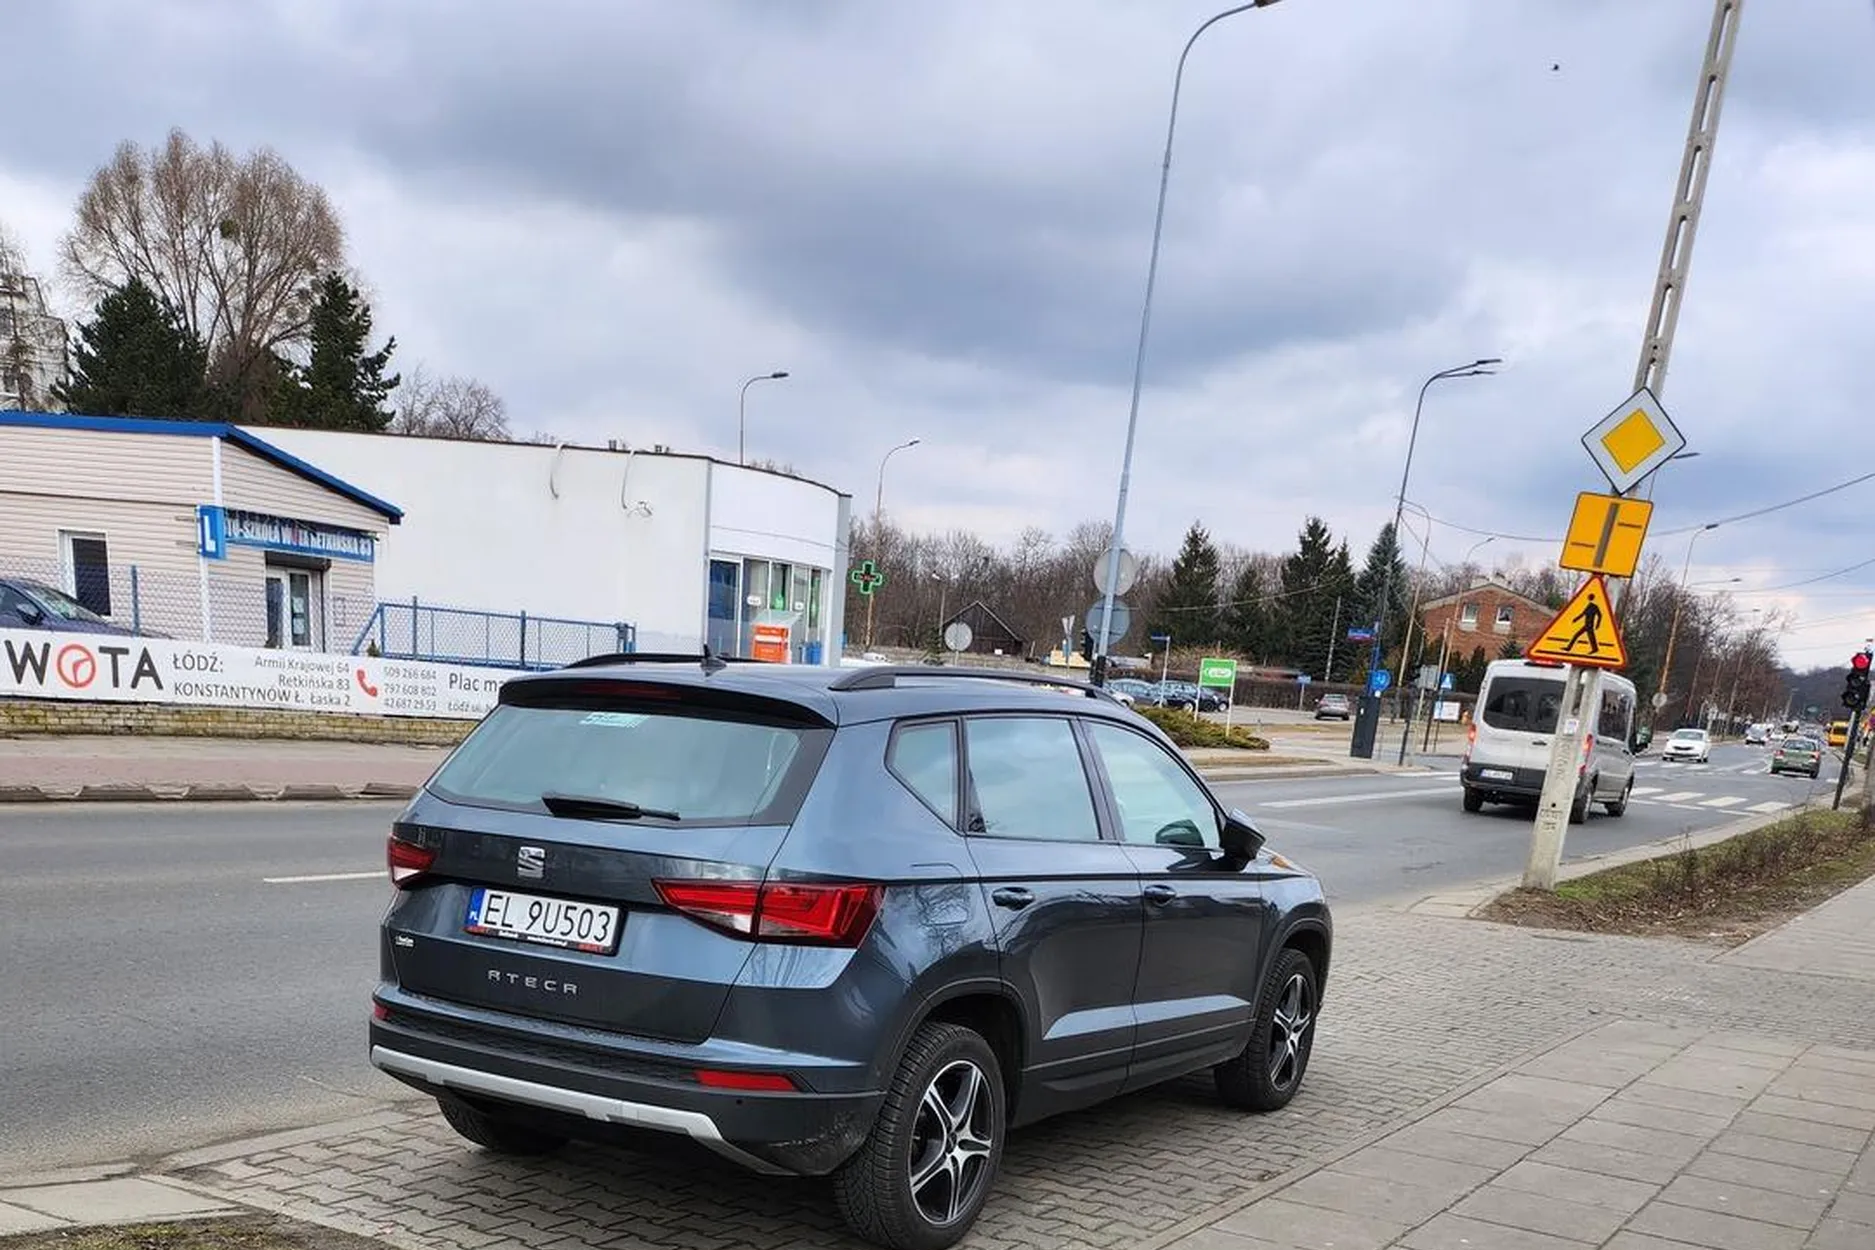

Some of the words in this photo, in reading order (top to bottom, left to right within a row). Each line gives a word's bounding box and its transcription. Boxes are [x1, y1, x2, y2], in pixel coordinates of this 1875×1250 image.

[203, 515, 216, 552] L
[4, 639, 164, 690] WOTA
[172, 650, 224, 673] ŁÓDŹ:
[254, 656, 286, 669] Armii
[287, 658, 335, 675] Krajowej
[336, 662, 350, 673] 64
[278, 673, 334, 689] Retkińska
[336, 678, 350, 691] 83
[402, 684, 418, 695] 608
[449, 672, 480, 691] Plac
[484, 680, 503, 691] m
[174, 681, 291, 702] KONSTANTYNÓW
[310, 692, 341, 706] Łaska
[344, 694, 352, 707] 2
[484, 893, 514, 929] EL
[525, 900, 612, 943] 9U503
[487, 969, 578, 995] ATECA
